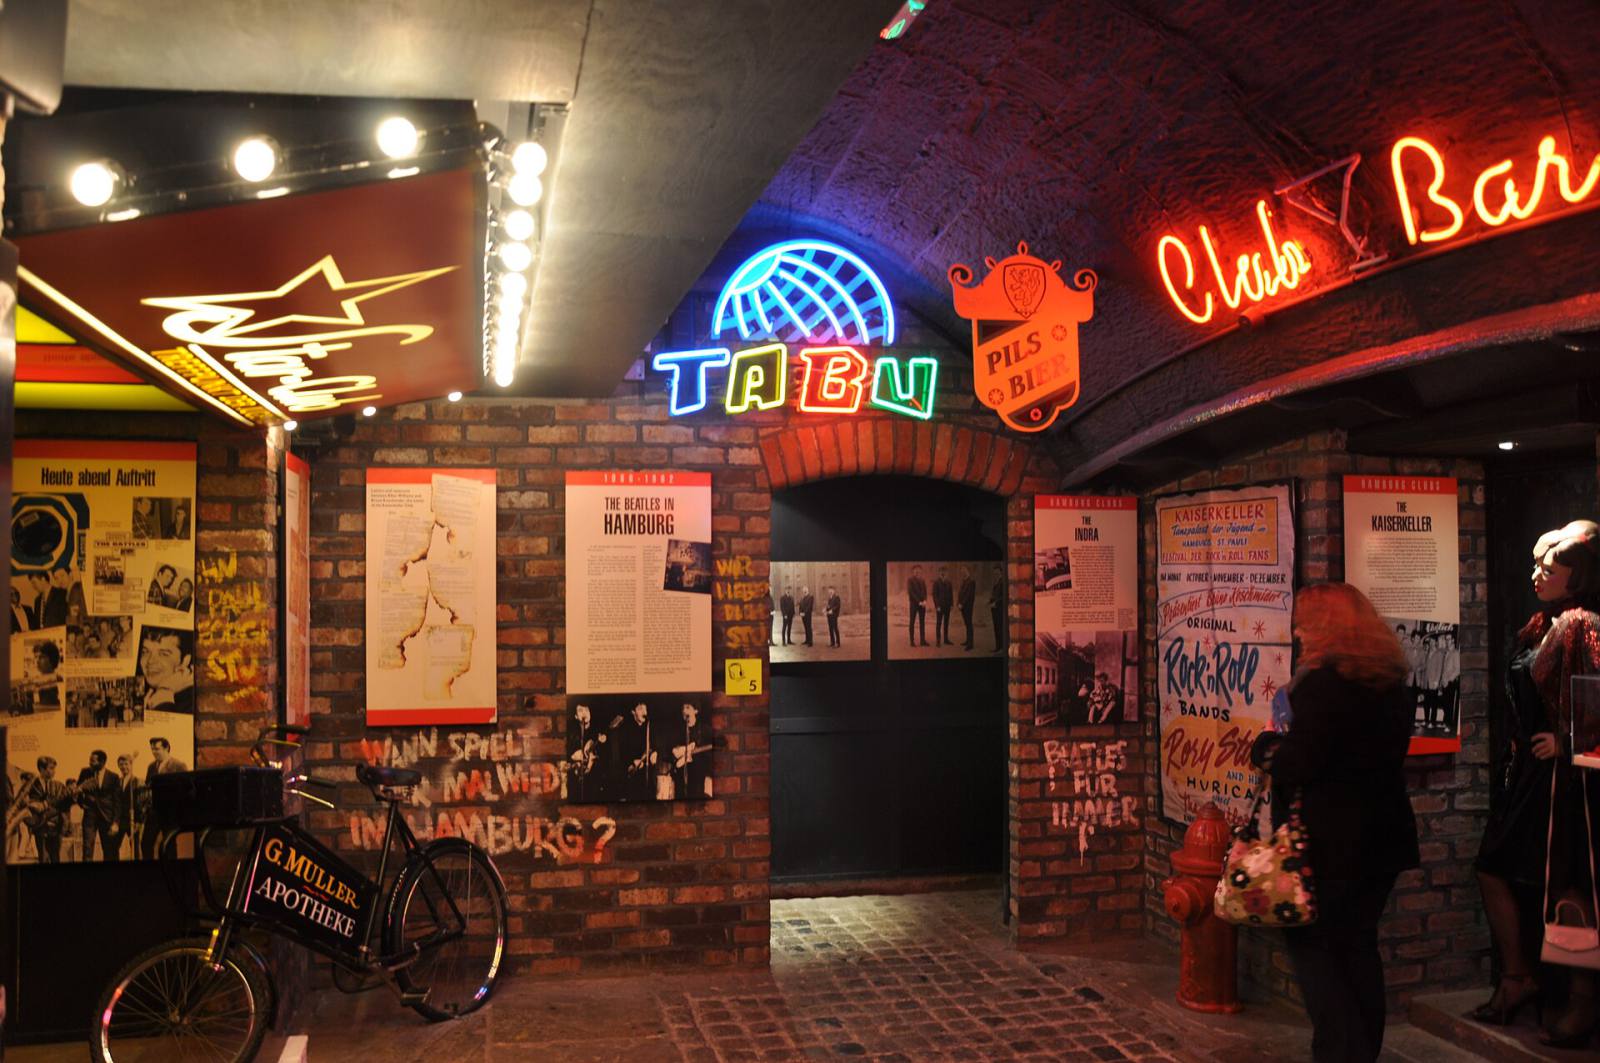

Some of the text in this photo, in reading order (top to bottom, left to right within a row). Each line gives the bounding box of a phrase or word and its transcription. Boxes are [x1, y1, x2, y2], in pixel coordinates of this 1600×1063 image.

[1157, 135, 1600, 324] Club Bar
[986, 331, 1042, 376] PILS
[652, 342, 938, 420] TABU
[1008, 353, 1070, 400] BIER
[41, 467, 156, 487] Heute abend Auftritt
[605, 497, 675, 511] THE BEATLES IN
[1174, 503, 1265, 523] KAISERKELLER
[1396, 501, 1407, 513] THE
[604, 513, 675, 536] HAMBURG
[1081, 516, 1092, 526] THE
[1371, 515, 1432, 533] KAISERKELLER
[1074, 527, 1099, 542] INDRA
[1249, 550, 1270, 562] FANS
[715, 555, 754, 579] WIR
[1249, 572, 1287, 584] DEZEMBER
[1186, 616, 1237, 633] ORIGINAL
[725, 622, 767, 649] STU
[749, 679, 757, 692] 5
[1178, 699, 1231, 723] BANDS
[254, 876, 357, 939] APOTHEKE
